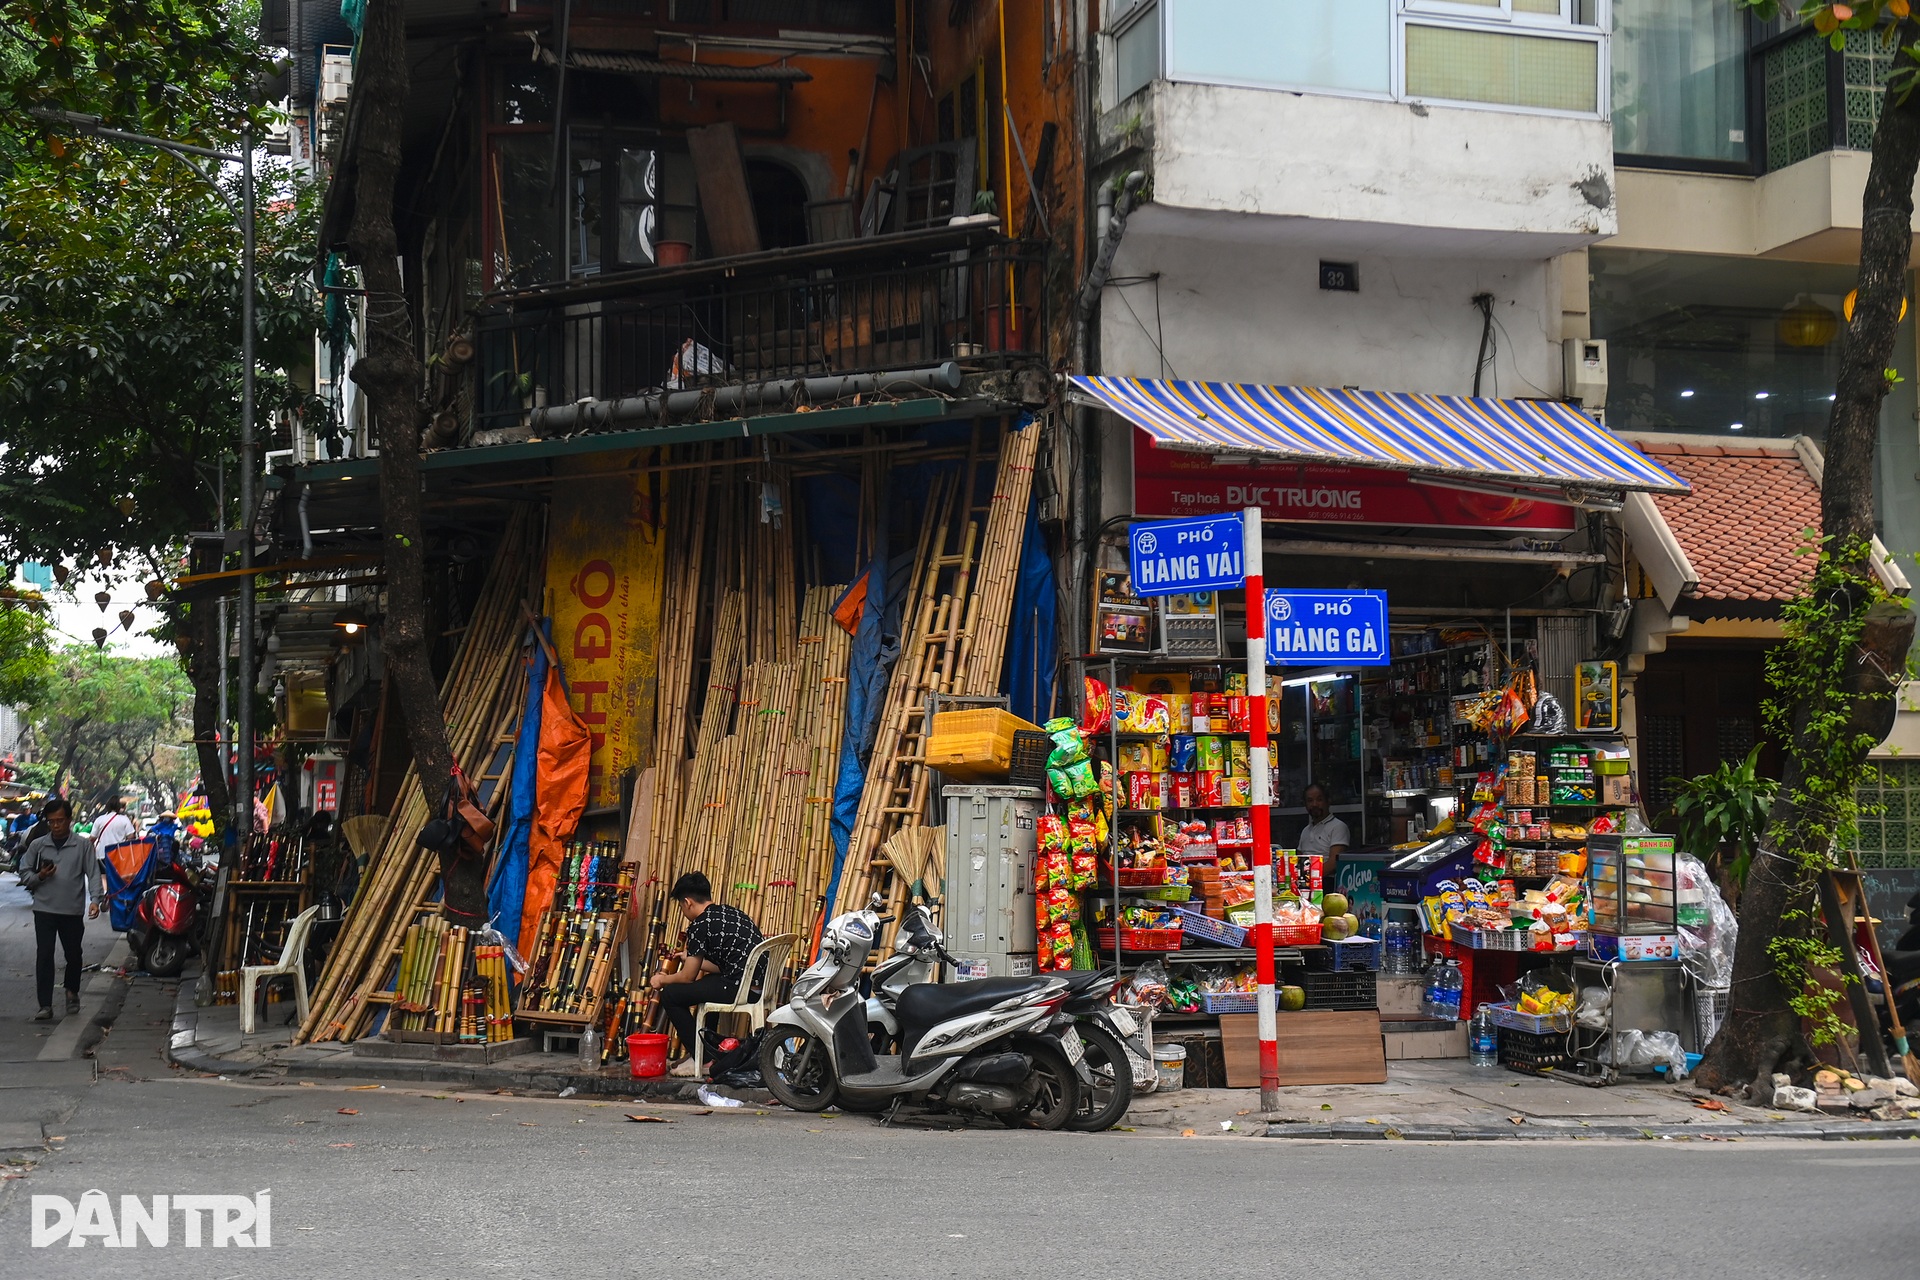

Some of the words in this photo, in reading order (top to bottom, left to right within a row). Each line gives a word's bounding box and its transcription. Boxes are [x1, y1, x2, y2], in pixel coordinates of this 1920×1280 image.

[1328, 271, 1345, 287] 33
[1177, 523, 1214, 544] PHỐ
[1141, 552, 1200, 584] HÀNG
[1206, 541, 1241, 577] VẢI
[1314, 597, 1352, 616] PHỐ
[1275, 621, 1340, 653] HÀNG
[1346, 622, 1378, 653] GÀ
[1340, 863, 1372, 892] Celano
